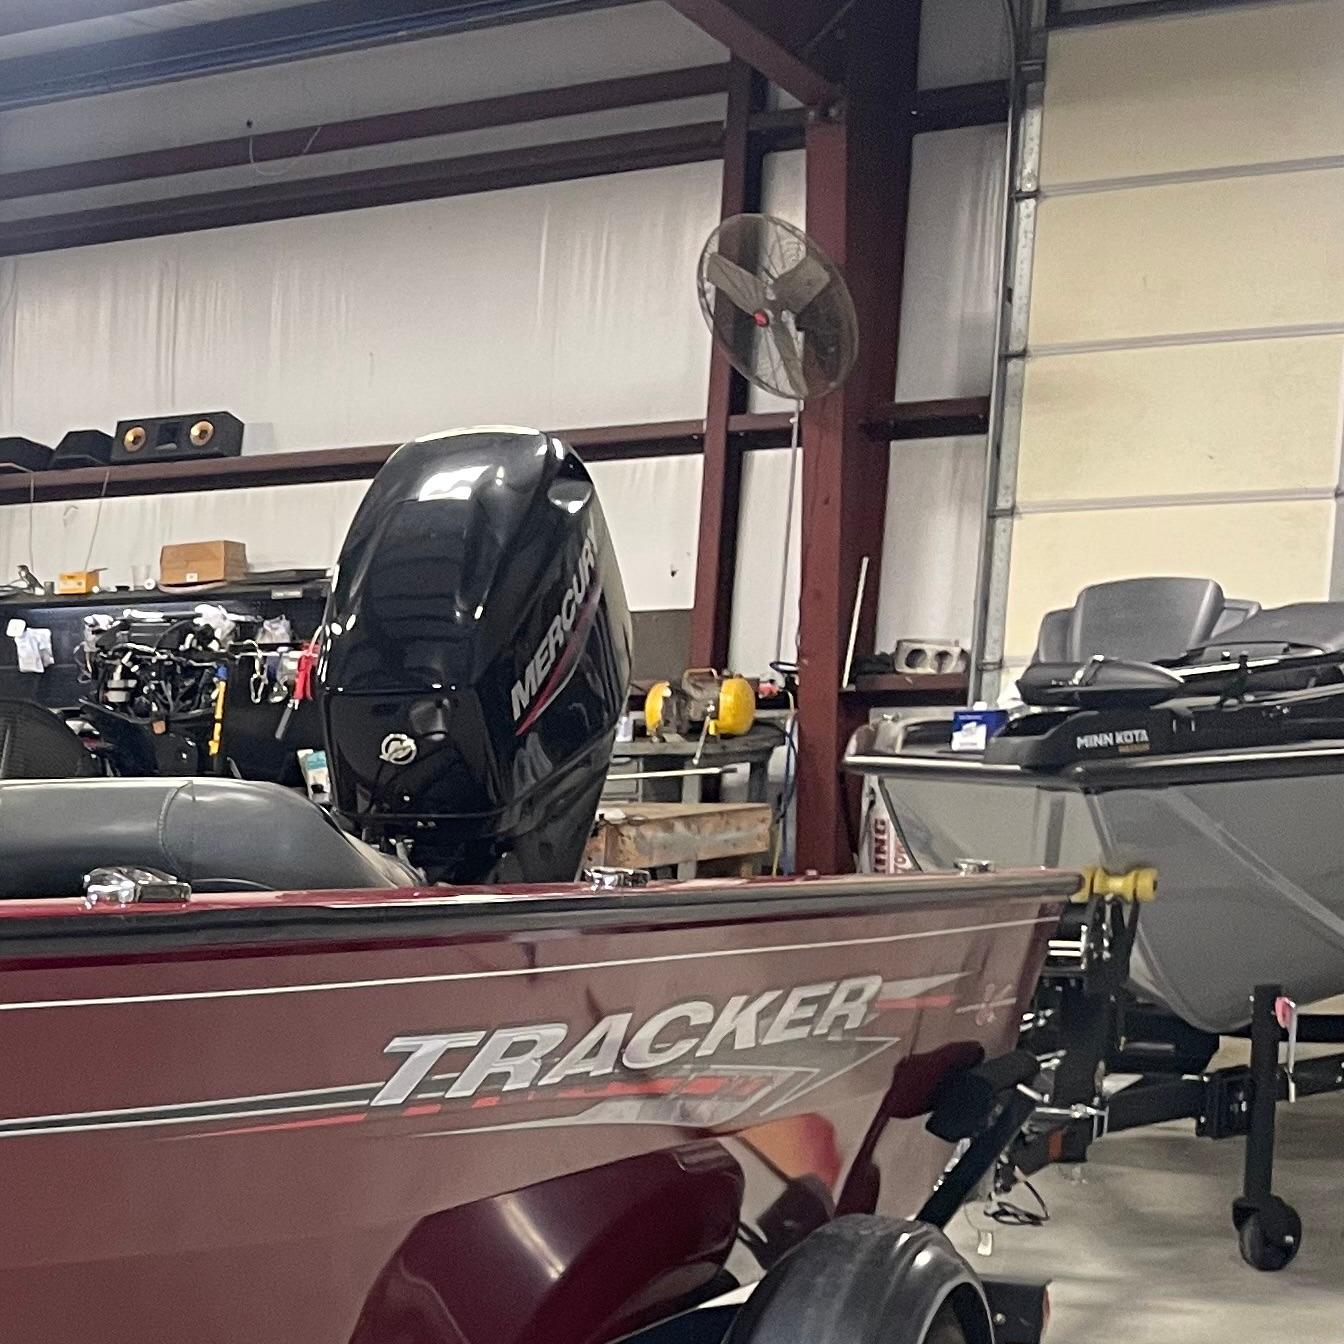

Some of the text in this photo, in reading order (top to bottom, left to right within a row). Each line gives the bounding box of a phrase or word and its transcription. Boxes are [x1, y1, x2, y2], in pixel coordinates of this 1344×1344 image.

[511, 514, 598, 721] MERCURY
[1076, 731, 1114, 751] MINN
[1114, 728, 1150, 745] KOTA
[367, 974, 884, 1107] TRACKER
